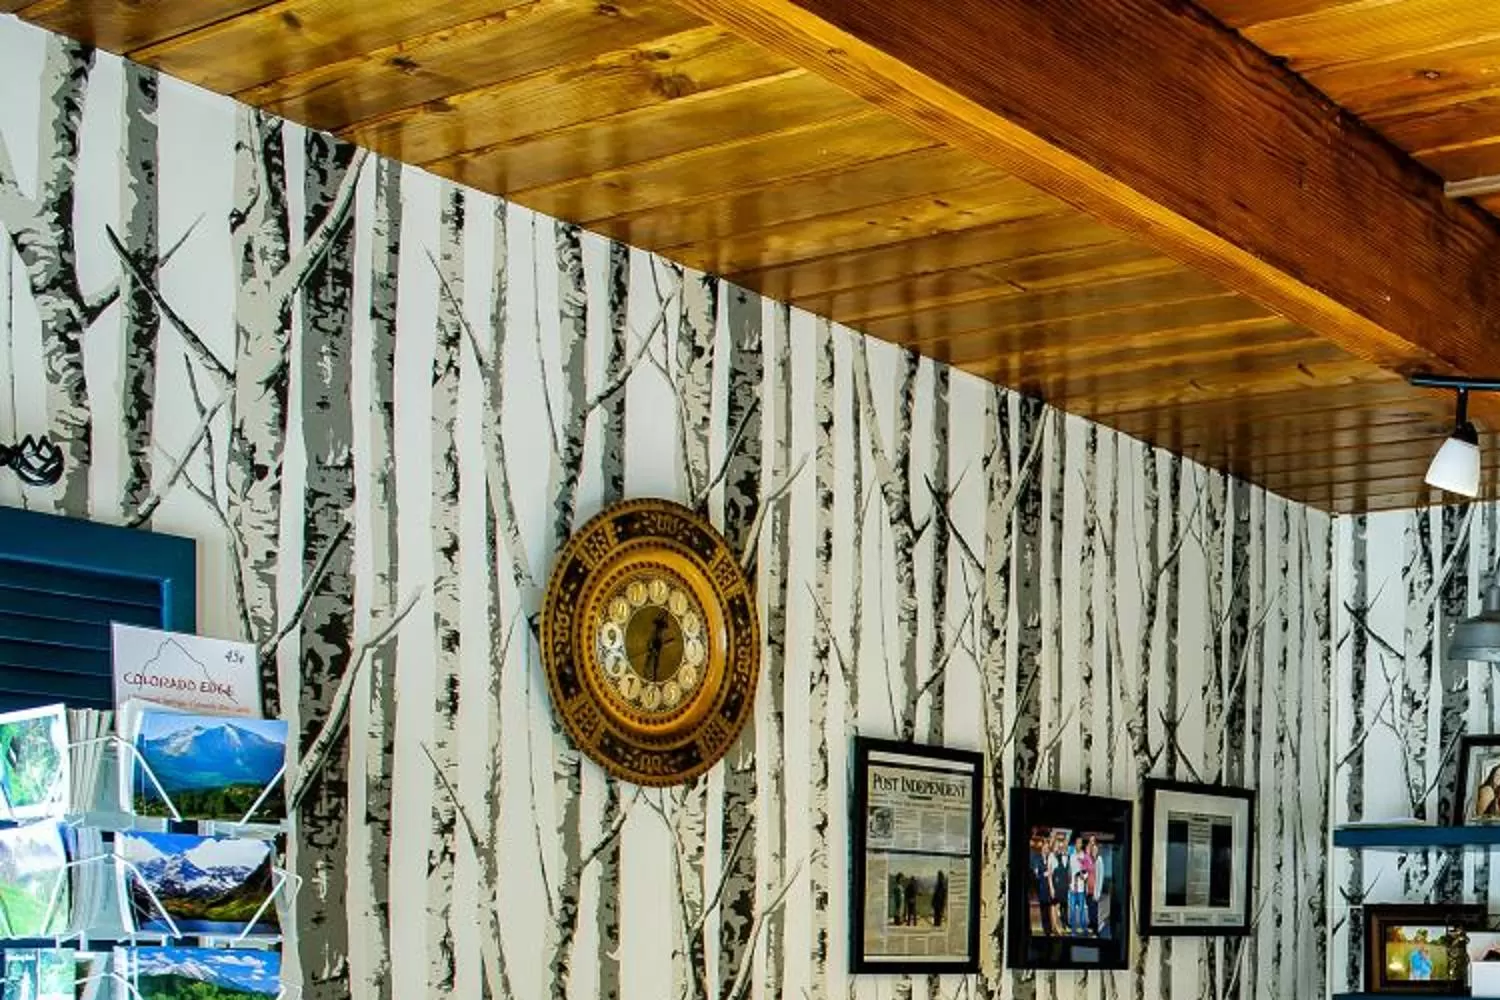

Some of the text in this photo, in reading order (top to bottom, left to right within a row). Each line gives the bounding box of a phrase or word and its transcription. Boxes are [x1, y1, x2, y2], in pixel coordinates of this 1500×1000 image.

[123, 672, 197, 691] COLORADO
[873, 772, 966, 798] POST INDEPENDENT
